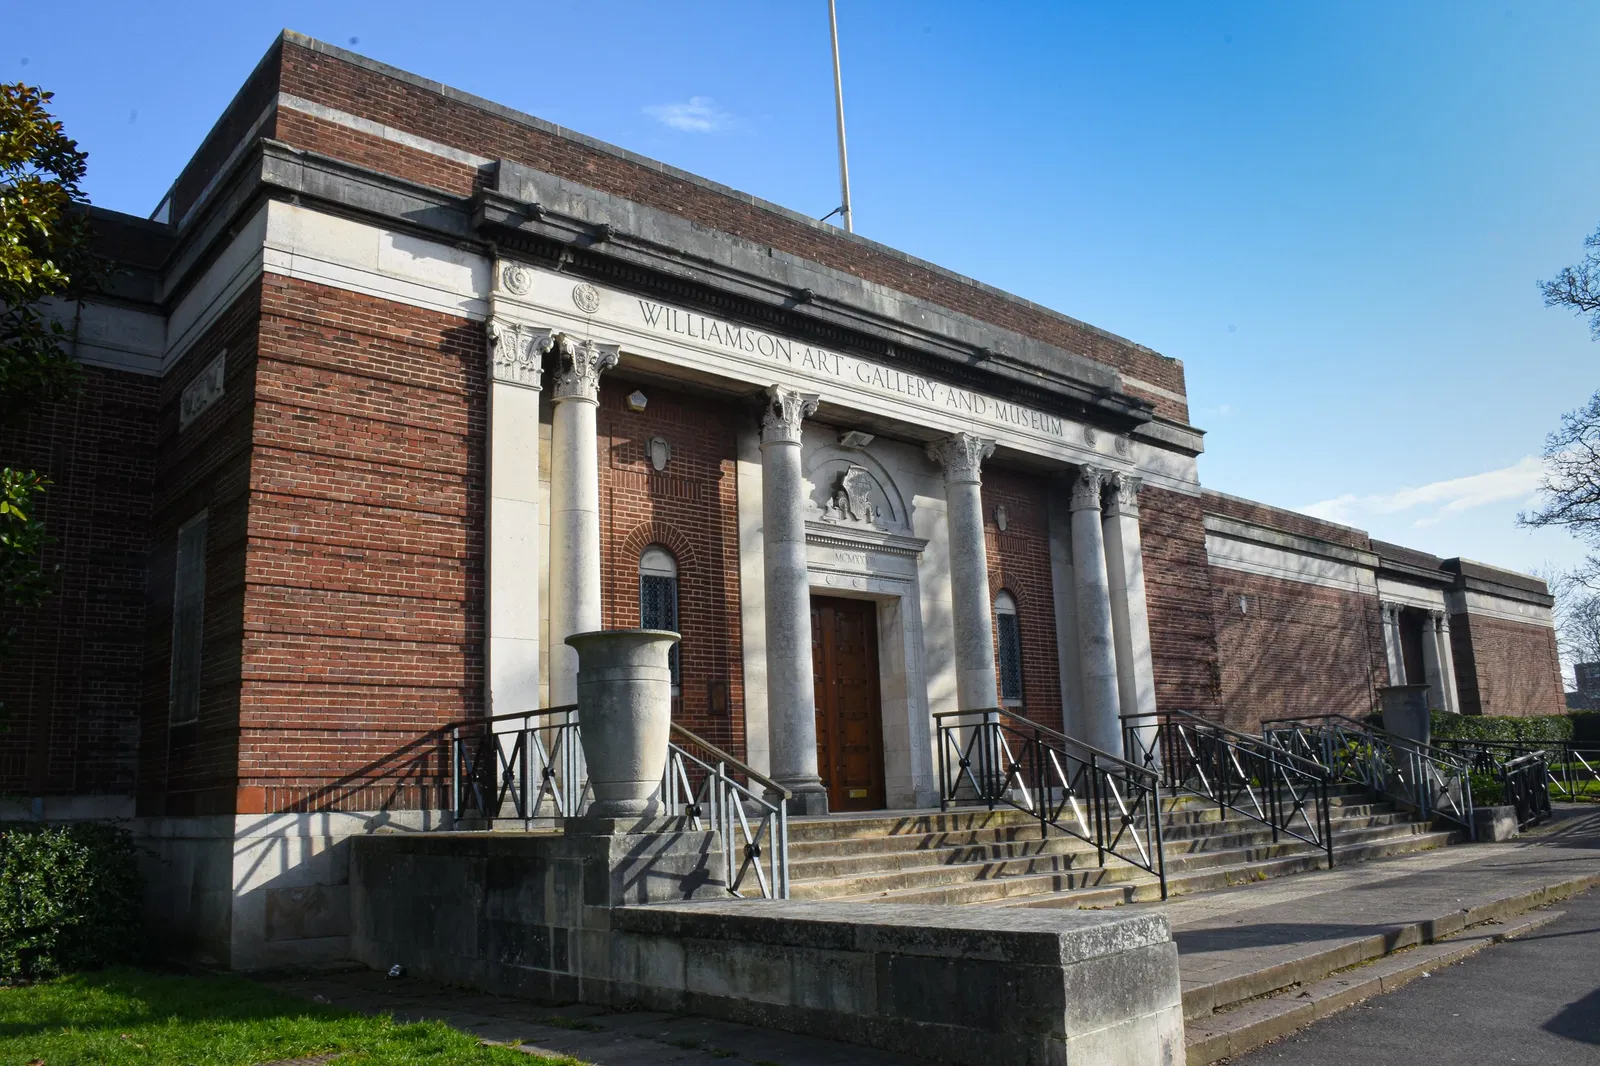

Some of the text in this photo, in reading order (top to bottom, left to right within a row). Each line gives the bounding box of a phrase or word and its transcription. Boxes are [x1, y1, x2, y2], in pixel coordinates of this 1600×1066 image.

[637, 299, 1064, 437] WILLIAMSON ART GALLERY AND MUSEUM
